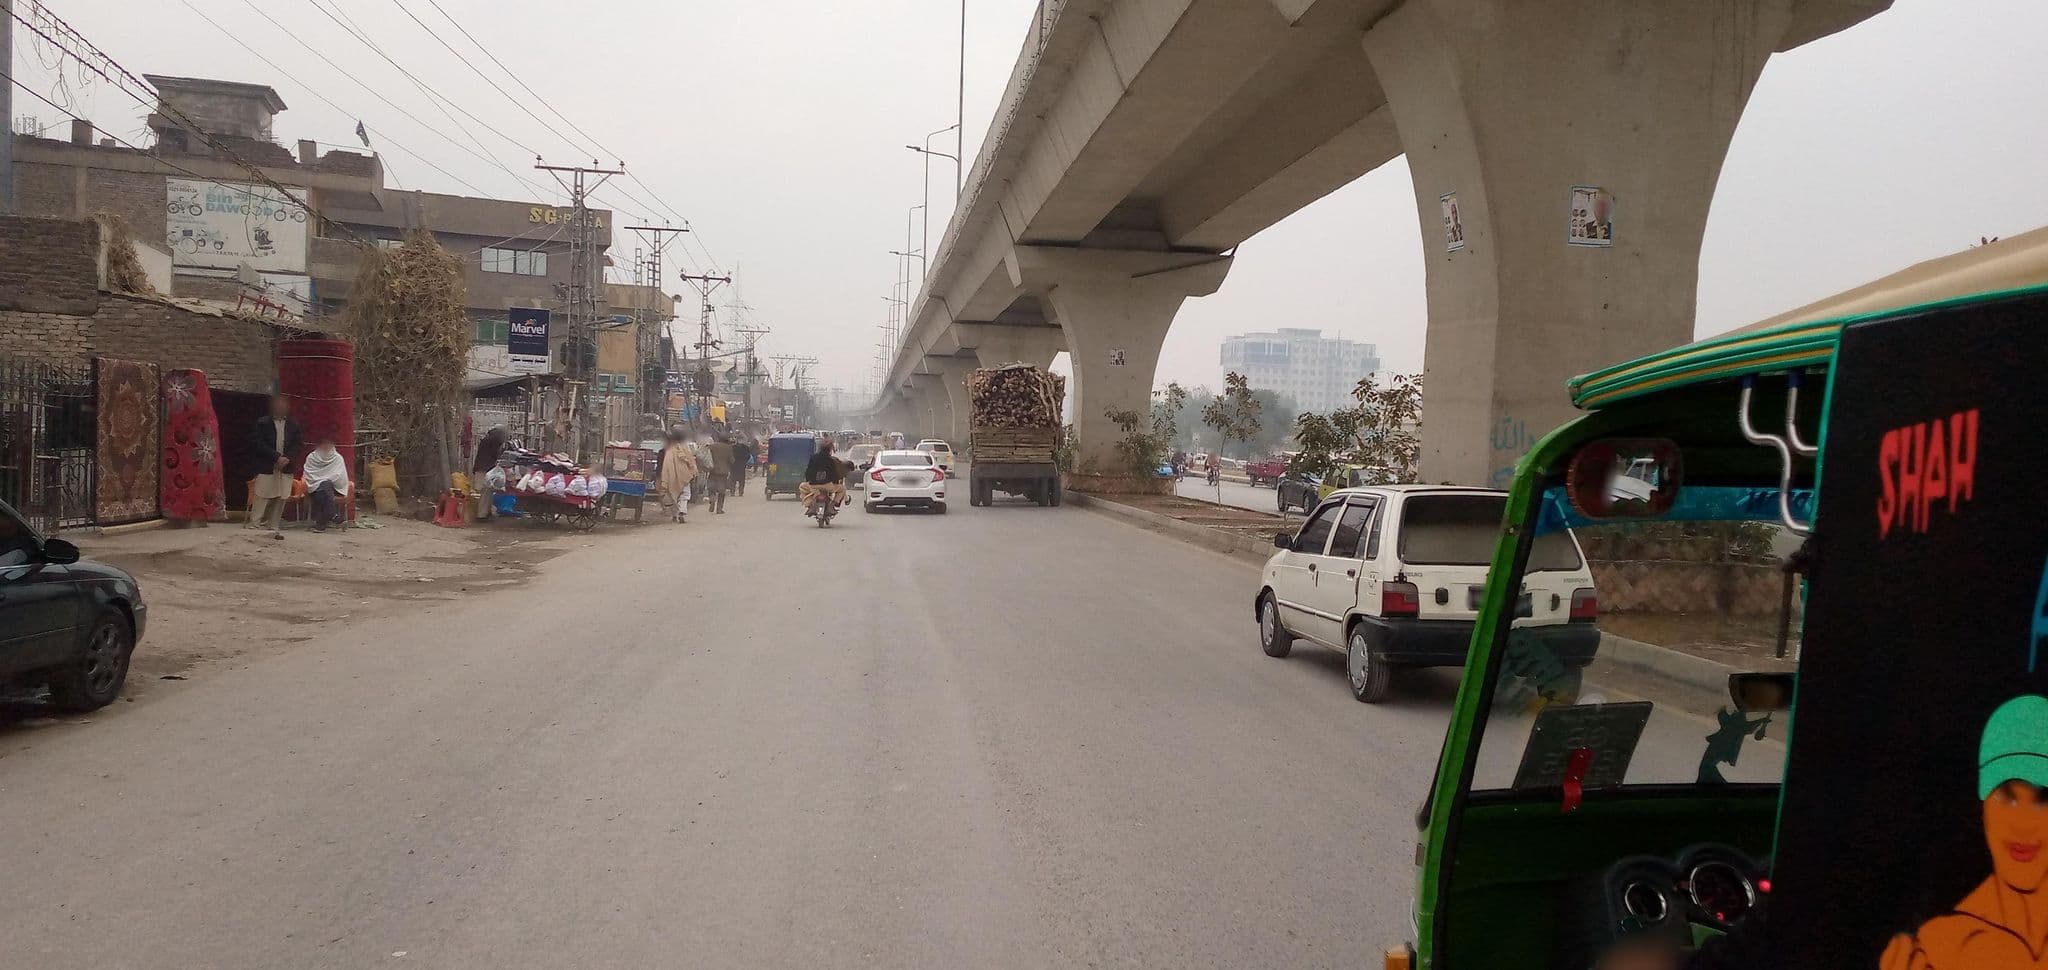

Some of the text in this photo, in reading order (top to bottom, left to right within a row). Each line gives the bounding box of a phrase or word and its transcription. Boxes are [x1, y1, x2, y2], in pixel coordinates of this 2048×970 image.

[530, 207, 557, 225] SG
[511, 322, 545, 335] Marvel
[1877, 408, 1980, 541] SHAH
